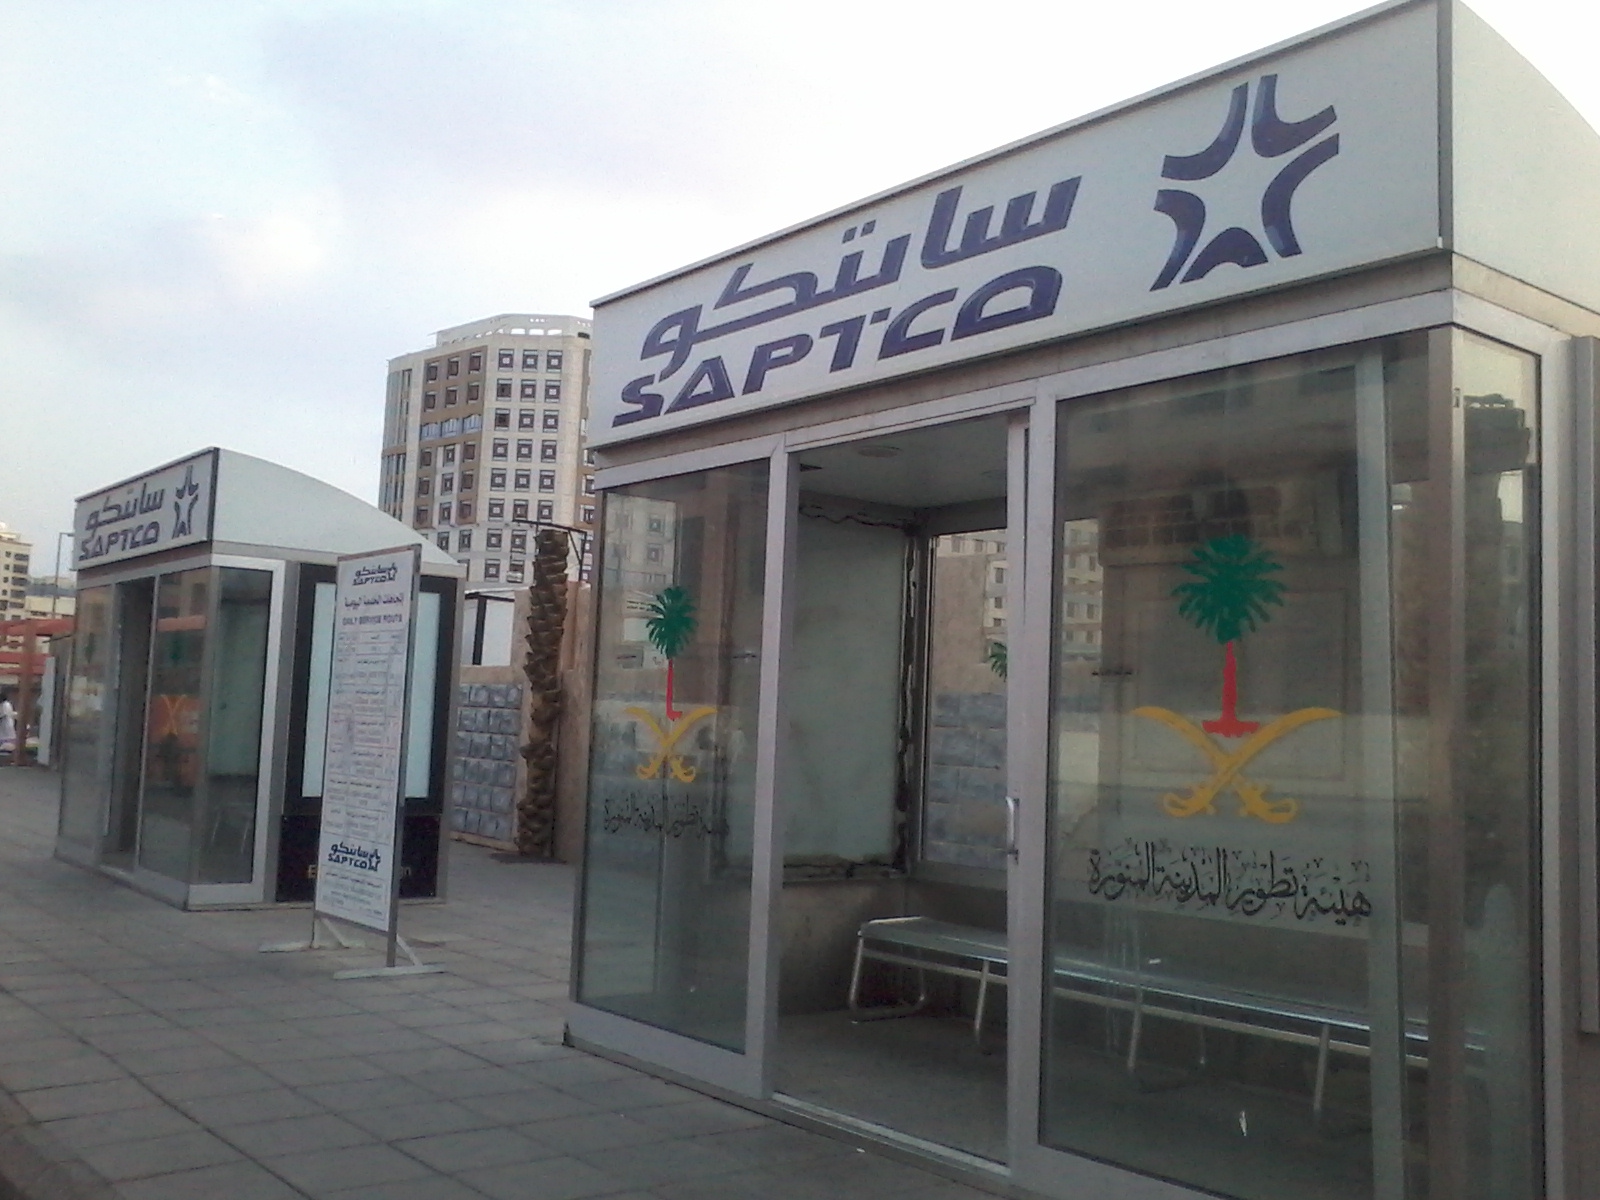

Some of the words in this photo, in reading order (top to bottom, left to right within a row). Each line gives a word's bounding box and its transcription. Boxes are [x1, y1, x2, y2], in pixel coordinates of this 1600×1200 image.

[611, 265, 1063, 428] SAPTCO
[79, 521, 160, 561] SAPTCO
[328, 852, 368, 870] SAPTCO
